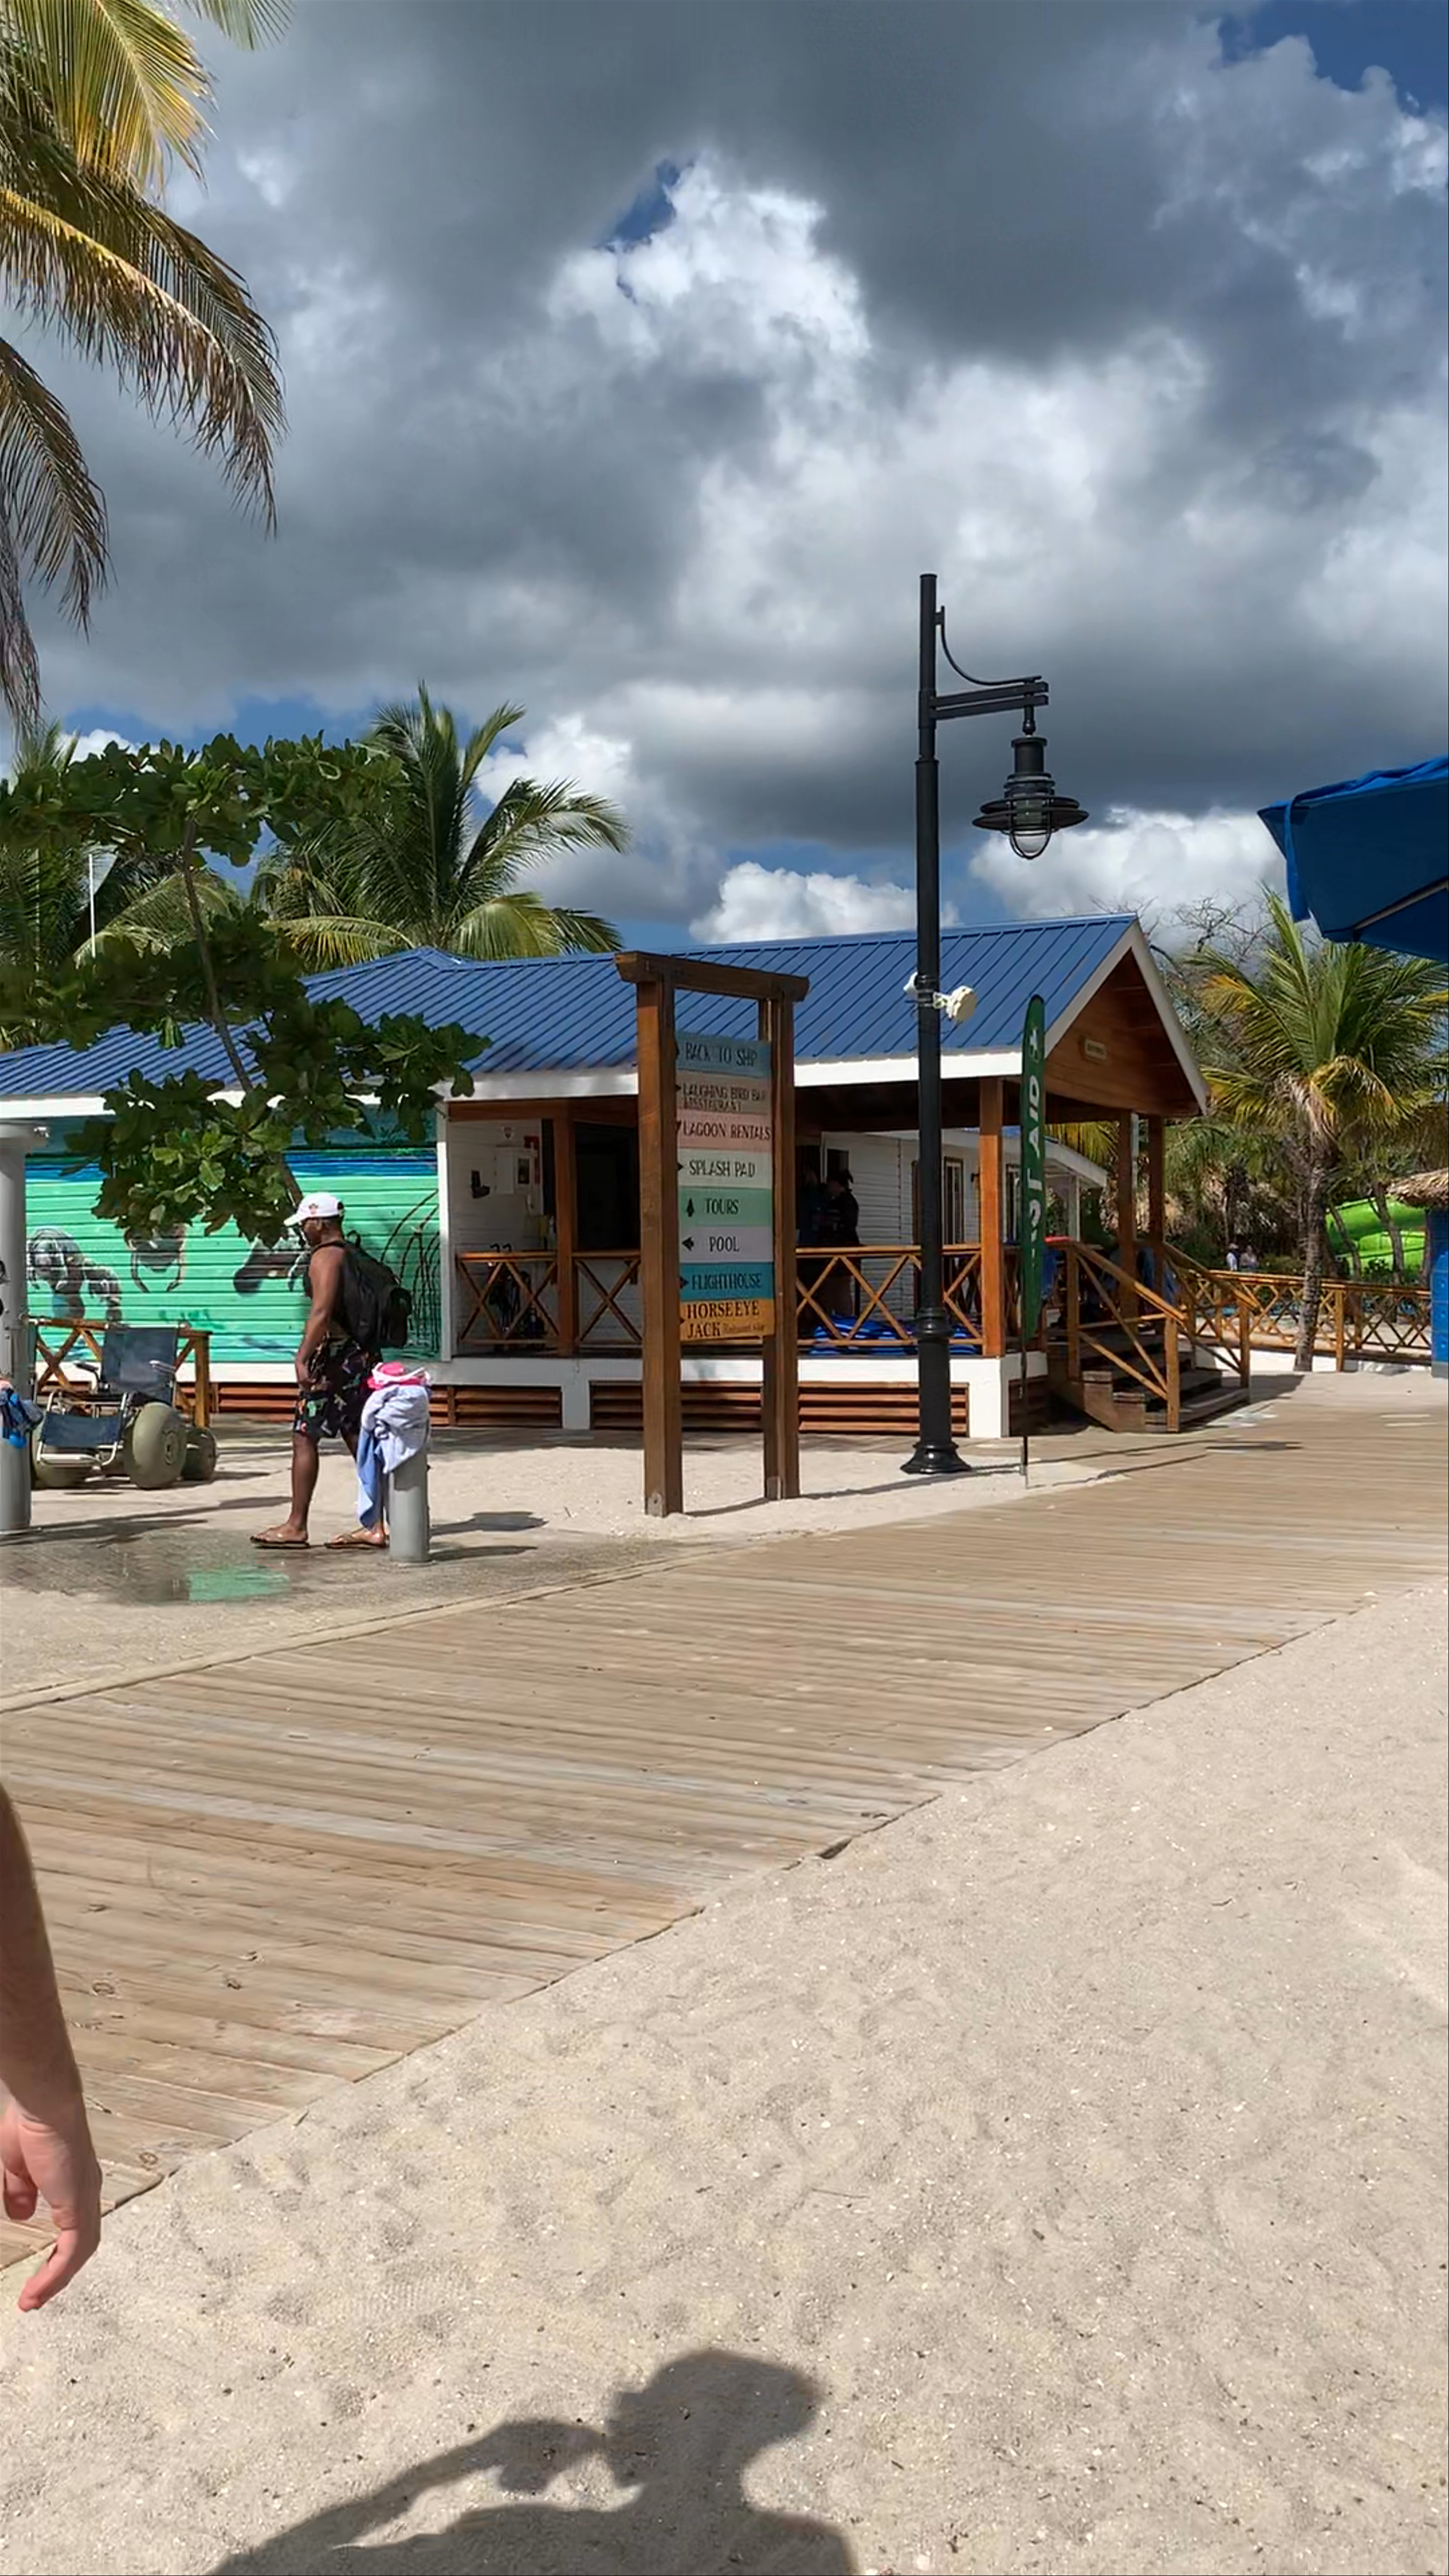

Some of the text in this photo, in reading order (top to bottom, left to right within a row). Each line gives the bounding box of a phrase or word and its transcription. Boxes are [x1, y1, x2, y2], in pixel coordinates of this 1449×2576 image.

[686, 1042, 711, 1061] BACK
[718, 1047, 732, 1064] TO
[1029, 1075, 1040, 1159] AID
[683, 1121, 770, 1140] LAGOON RENTALS
[689, 1159, 755, 1178] SPLASH PAD
[705, 1198, 739, 1214] TOURS
[709, 1236, 740, 1252] POOL
[687, 1322, 720, 1339] JACK
